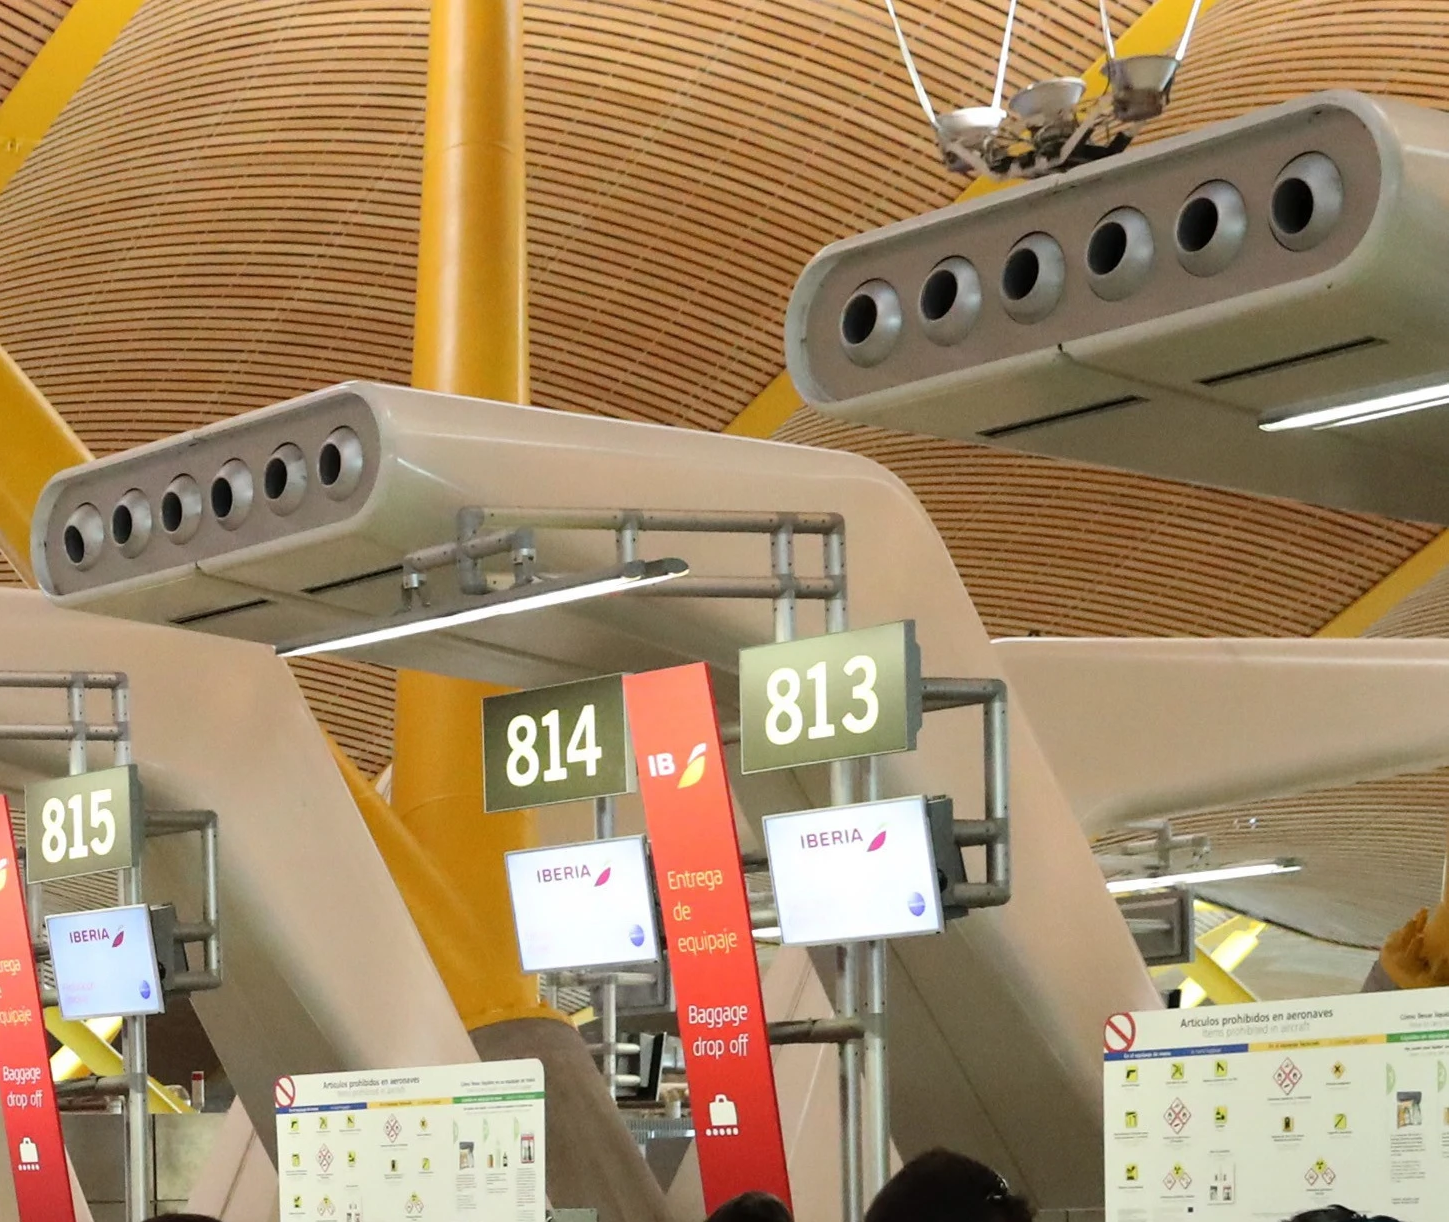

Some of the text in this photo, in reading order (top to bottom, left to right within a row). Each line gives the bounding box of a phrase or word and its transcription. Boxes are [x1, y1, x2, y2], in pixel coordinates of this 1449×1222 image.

[764, 654, 879, 746] 813
[505, 703, 602, 788] 814
[648, 753, 675, 778] IB
[41, 789, 116, 863] 815
[800, 827, 863, 850] IBERIA
[536, 864, 591, 884] IBERIA
[667, 866, 724, 892] Entrega
[673, 901, 691, 922] de
[69, 928, 110, 944] IBERIA
[678, 930, 738, 956] equipaje
[688, 1002, 748, 1028] Baggage
[1222, 1011, 1271, 1028] prohibidos
[1272, 1012, 1284, 1022] en
[1286, 1008, 1333, 1021] aeronaves
[692, 1034, 749, 1060] drop off
[3, 1066, 41, 1084] Baggage
[7, 1089, 43, 1109] drop off
